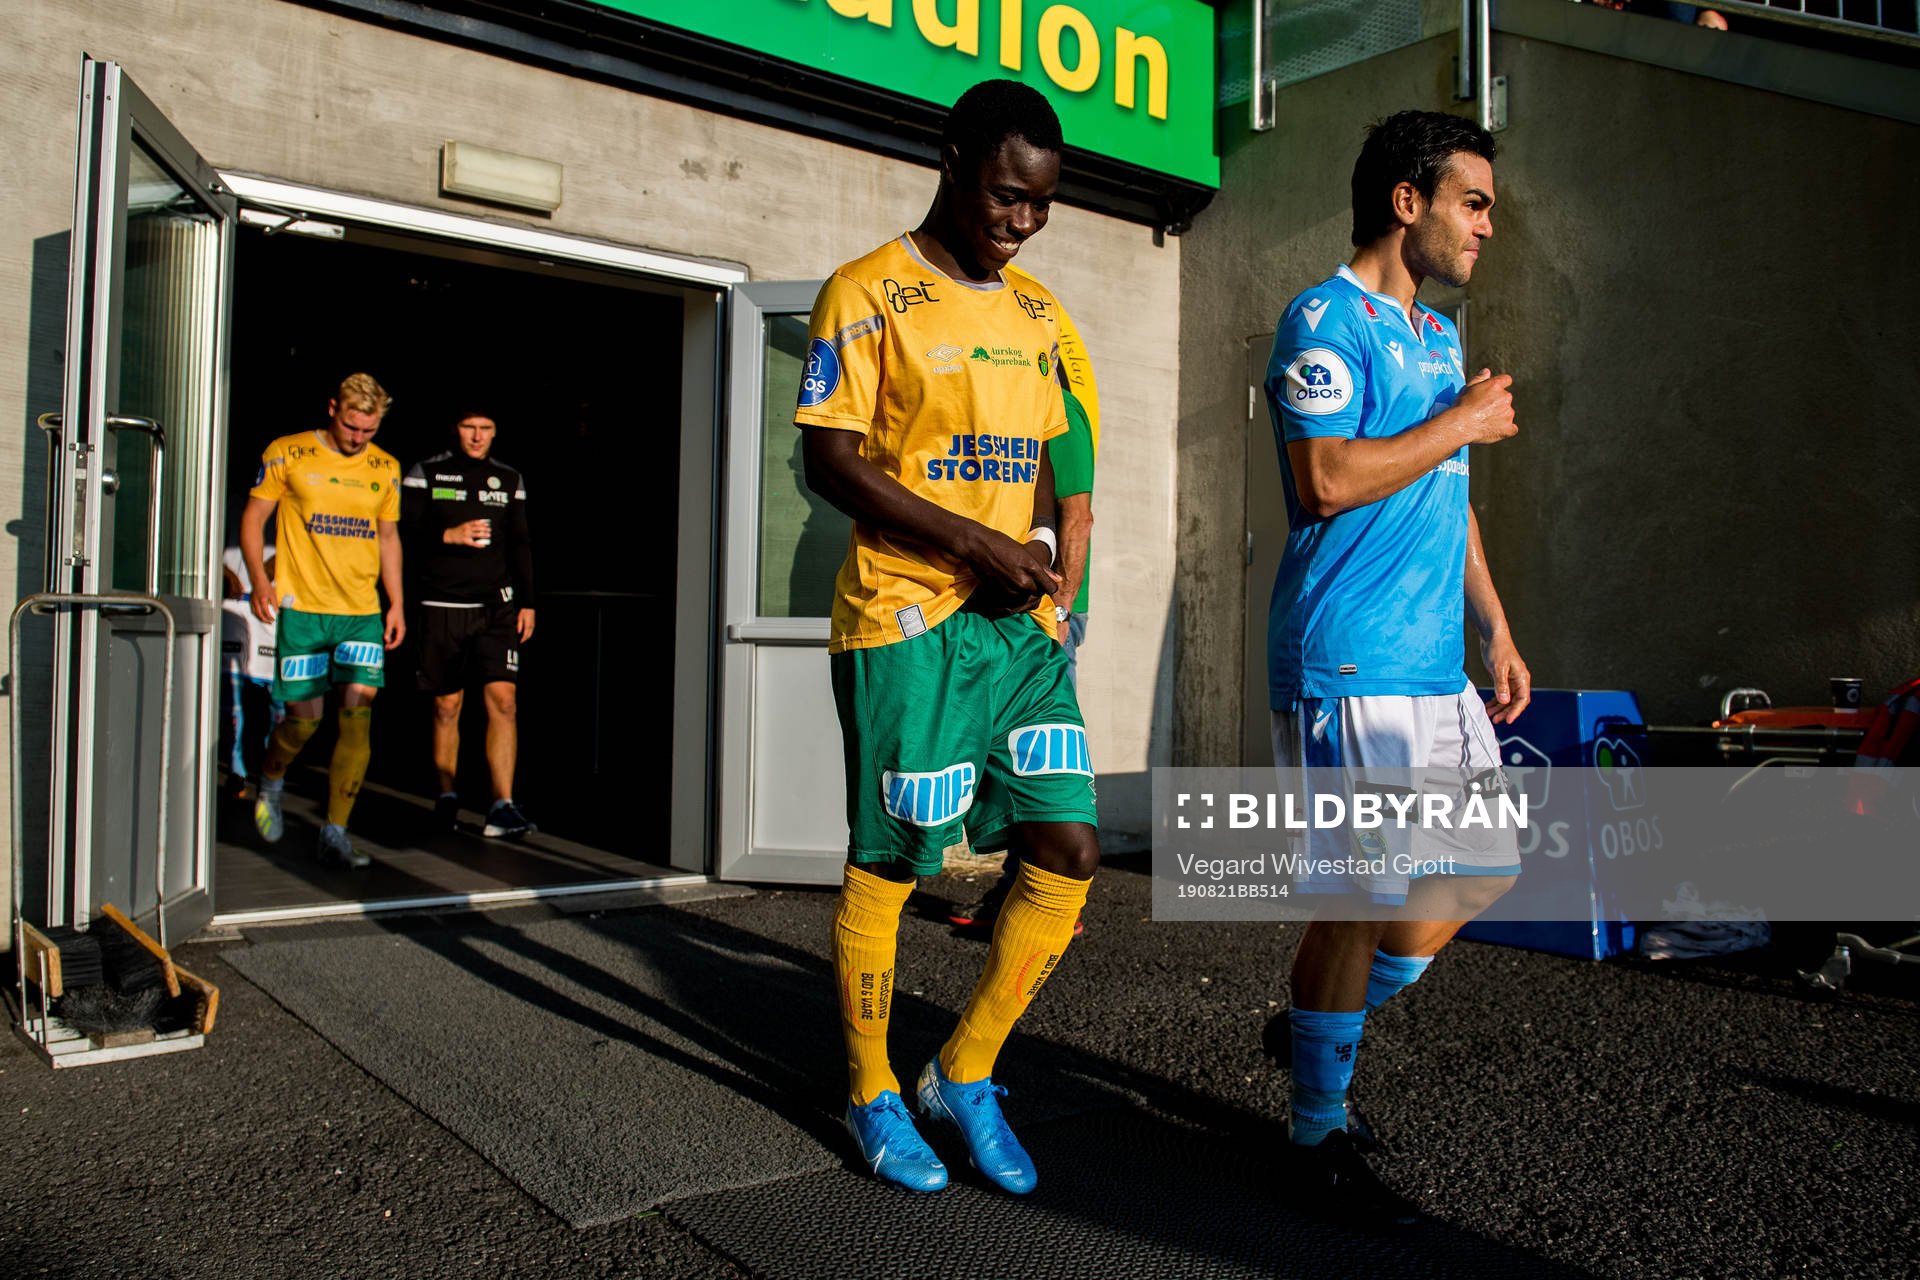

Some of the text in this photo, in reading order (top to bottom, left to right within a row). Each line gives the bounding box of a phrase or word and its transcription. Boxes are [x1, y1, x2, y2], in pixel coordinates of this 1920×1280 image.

[804, 378, 827, 394] OS
[1296, 388, 1343, 400] OBOS
[311, 513, 370, 528] JESSHEIM
[306, 524, 376, 539] TORSENTER
[1601, 815, 1663, 859] OBOS
[861, 973, 874, 989] BUD
[861, 998, 873, 1020] VARE
